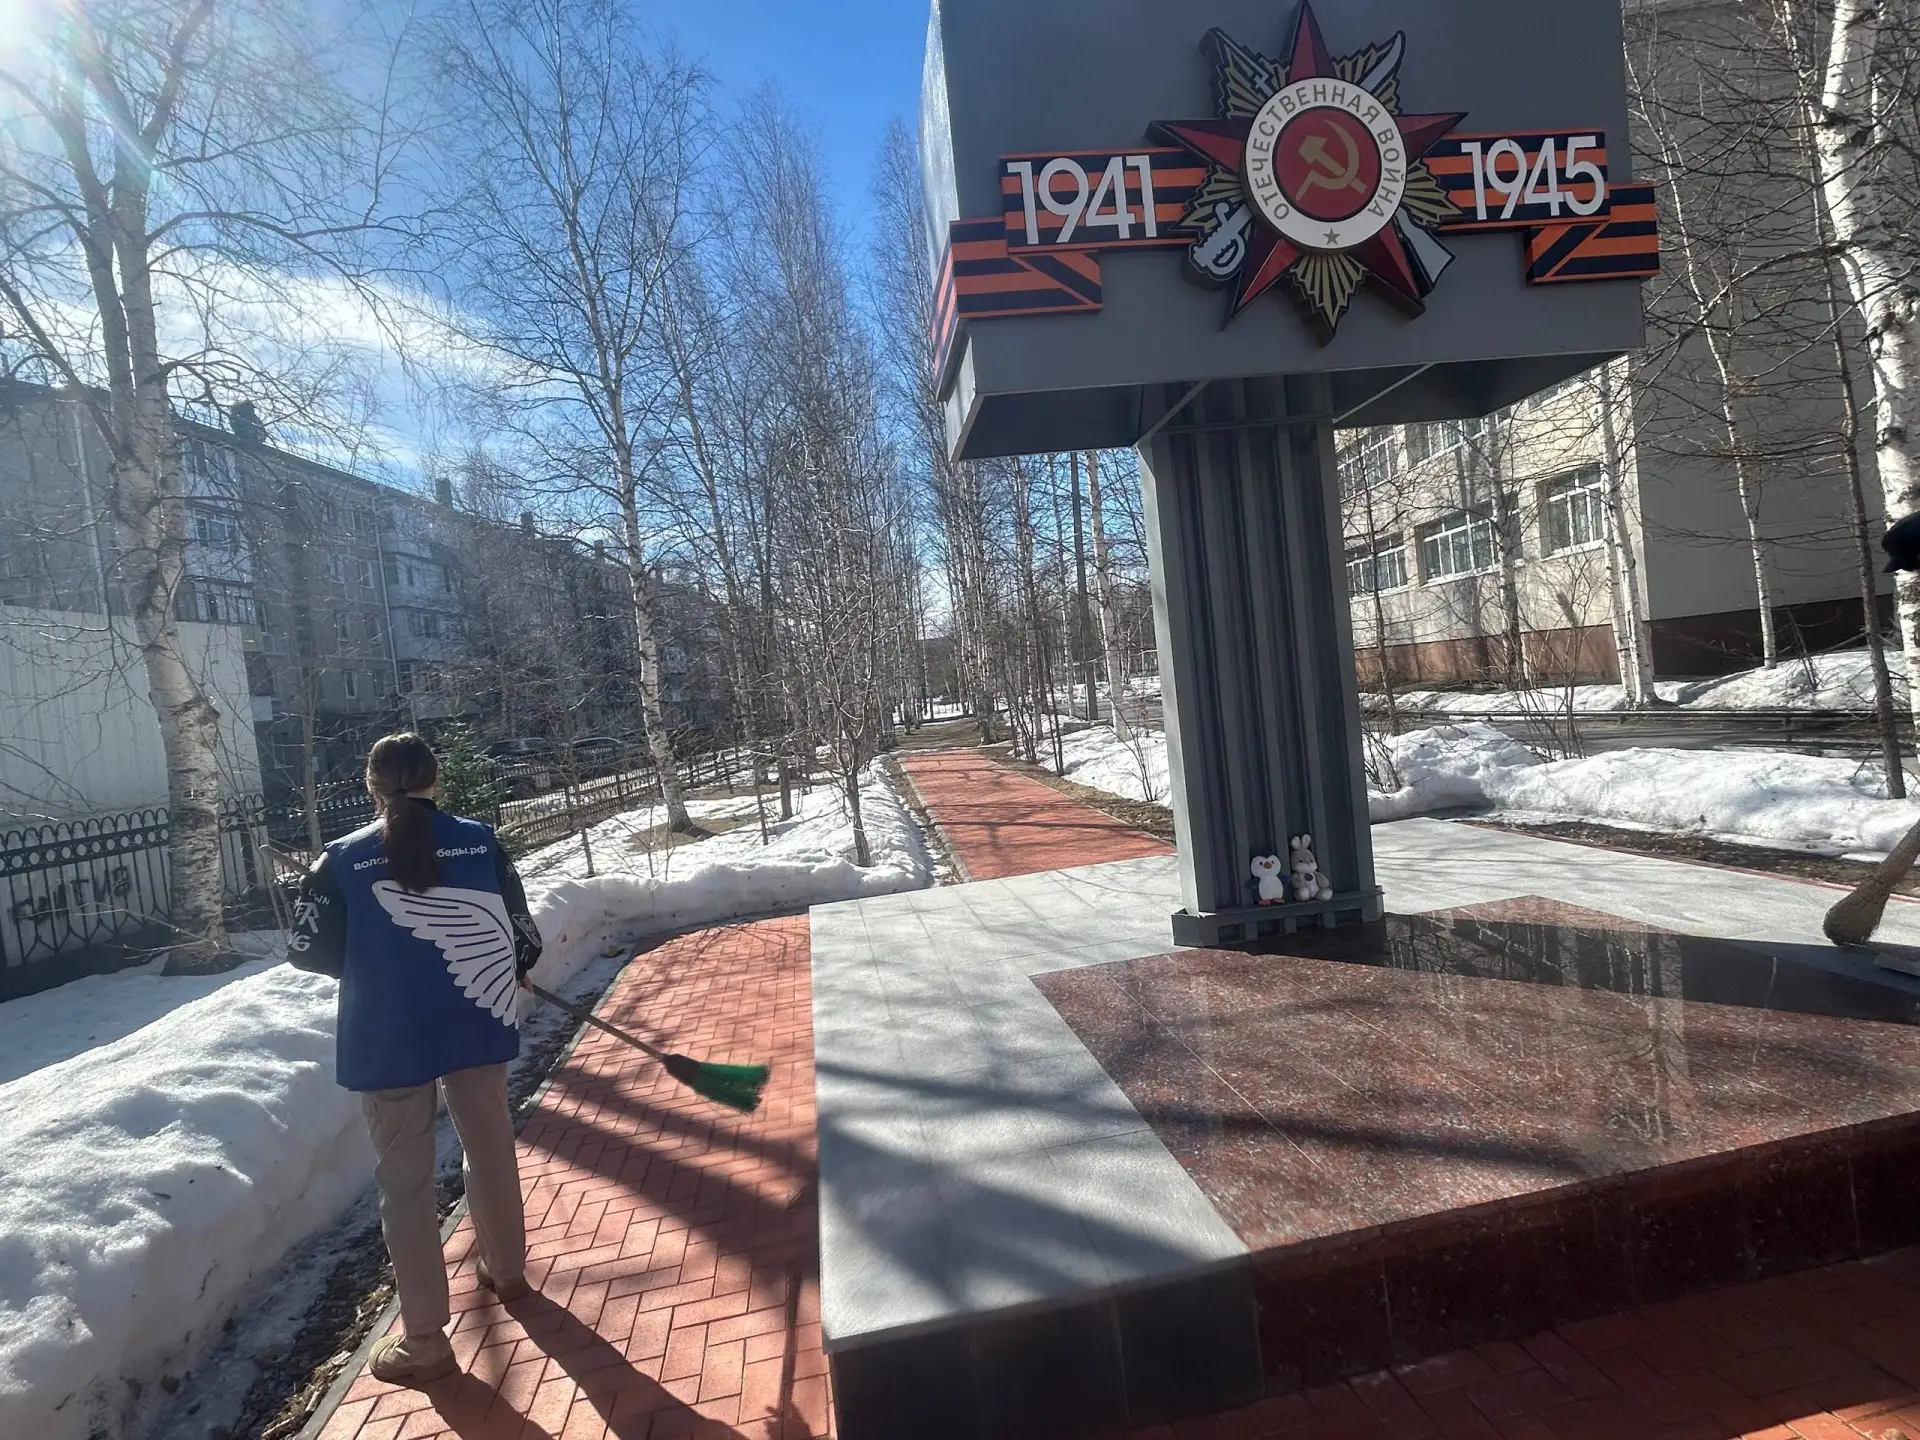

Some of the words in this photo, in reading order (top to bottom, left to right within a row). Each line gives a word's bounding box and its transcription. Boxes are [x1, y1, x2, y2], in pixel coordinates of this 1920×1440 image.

[1252, 84, 1381, 220] ОТЕЧЕСТВЕННАЯ
[1367, 127, 1404, 219] ВОЙНА
[1461, 135, 1605, 220] 1945
[1007, 155, 1157, 244] 1941
